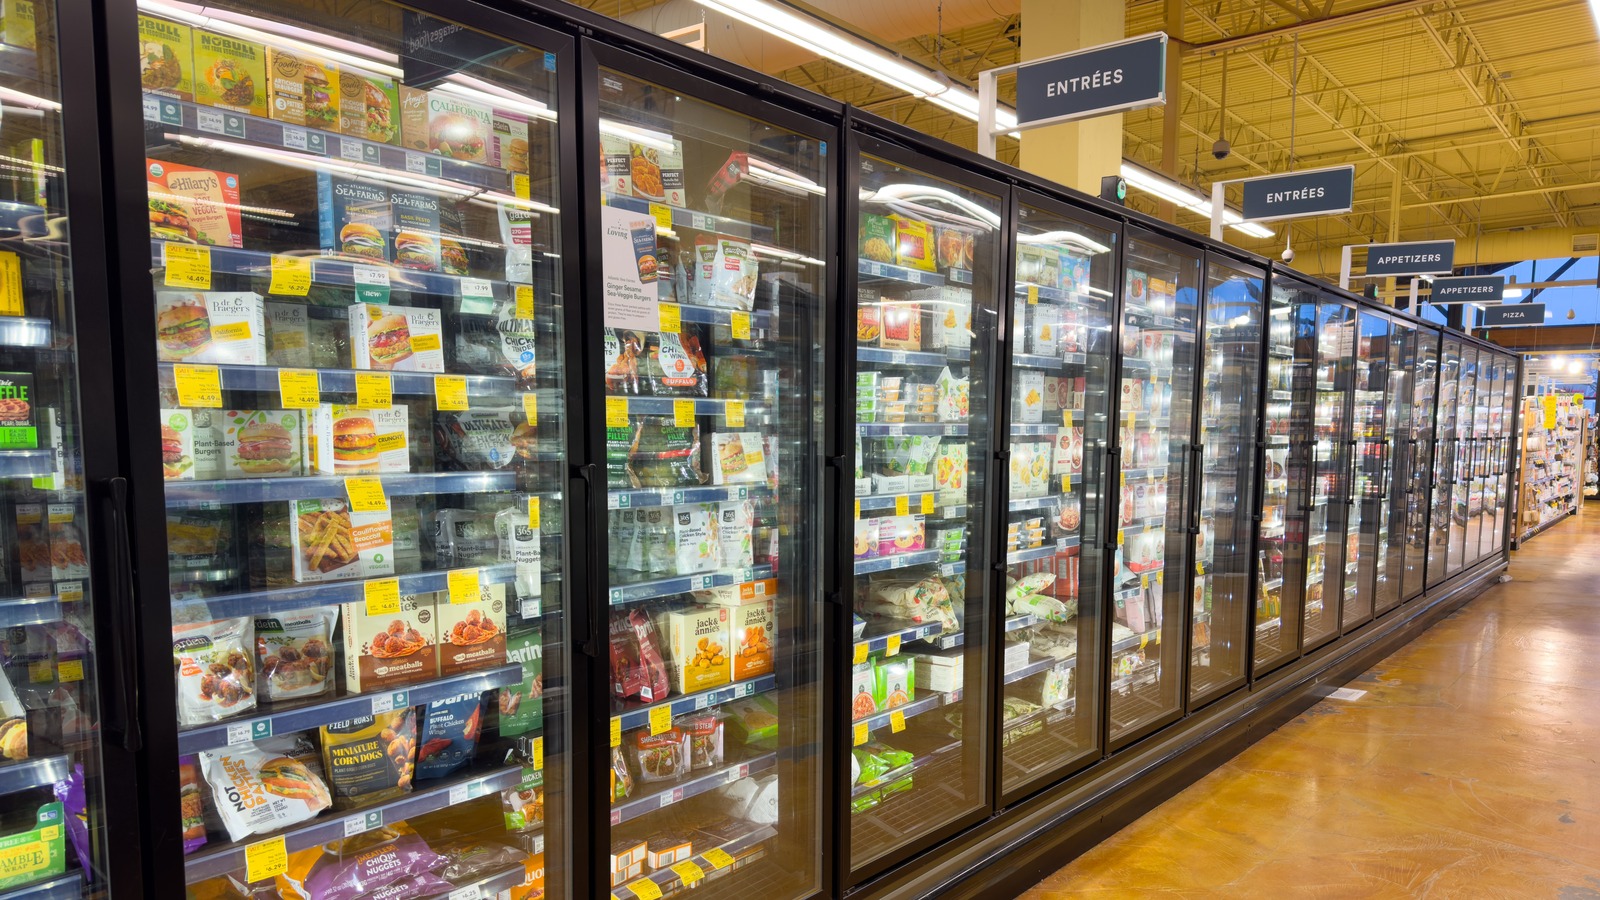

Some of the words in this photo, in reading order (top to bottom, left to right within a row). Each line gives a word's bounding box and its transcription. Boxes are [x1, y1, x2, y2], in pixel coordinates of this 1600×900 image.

[138, 18, 181, 37] OBULL
[201, 34, 255, 56] NOBULL
[1047, 69, 1123, 97] ENTRÉES
[403, 93, 426, 109] Amy's
[431, 99, 491, 125] CALIFORNIA
[177, 177, 217, 191] Hilary's
[1266, 187, 1325, 203] ENTRÉES
[607, 228, 628, 239] Loving
[1377, 254, 1441, 265] APPETIZERS
[607, 282, 623, 291] Ginger
[624, 284, 642, 293] Sesame
[1440, 286, 1494, 295] APPETIZERS
[607, 290, 633, 300] Sea-Veggie
[633, 293, 651, 302] Burgers
[463, 419, 508, 432] ULTIMATE
[661, 426, 689, 434] CHICKEN
[377, 434, 403, 444] CRUNCHY
[352, 525, 389, 537] Cauliflower
[516, 526, 532, 536] 365
[610, 617, 634, 635] aring
[745, 616, 766, 626] annie's
[695, 625, 720, 635] annie's
[173, 637, 207, 651] ardein
[466, 648, 495, 659] meatballs
[506, 641, 542, 664] arin
[389, 661, 423, 672] meatballs
[329, 720, 350, 730] FIELD
[354, 715, 373, 725] ROAST
[430, 714, 454, 724] BUFFALO
[444, 719, 464, 728] Chicken
[332, 741, 379, 757] MINIATURE
[333, 757, 359, 766] CORN
[360, 750, 383, 762] DOGS
[220, 756, 255, 809] CHICKEN
[235, 759, 267, 805] PATTIES
[522, 770, 543, 783] HICKEN
[224, 786, 246, 812] NOT
[0, 851, 44, 868] AMBLE
[366, 852, 397, 867] CHIQIN
[4, 864, 28, 873] WRAP
[366, 859, 401, 876] NUGGETS
[373, 884, 409, 900] NUGGETS
